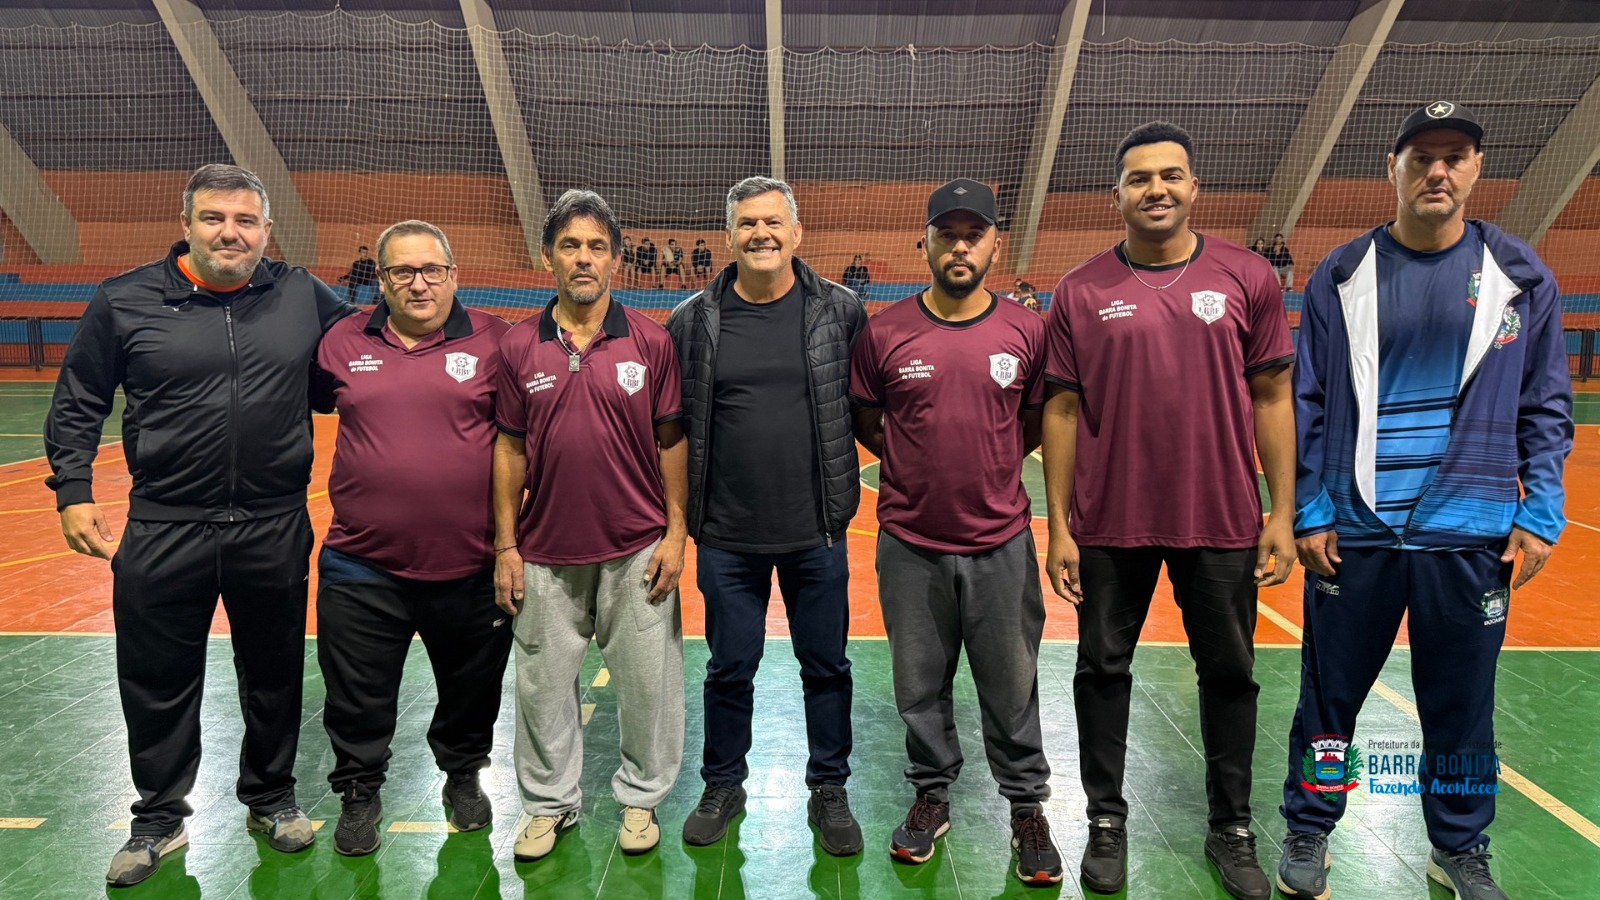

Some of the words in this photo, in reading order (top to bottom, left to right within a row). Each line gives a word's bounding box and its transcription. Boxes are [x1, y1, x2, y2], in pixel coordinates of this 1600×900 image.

[1098, 307, 1116, 316] BARRA
[1109, 310, 1134, 319] FUTEBOL
[534, 372, 544, 380] LIGA
[526, 380, 540, 388] BARRA
[540, 375, 556, 384] BONITA
[534, 382, 554, 392] FUTEBOL
